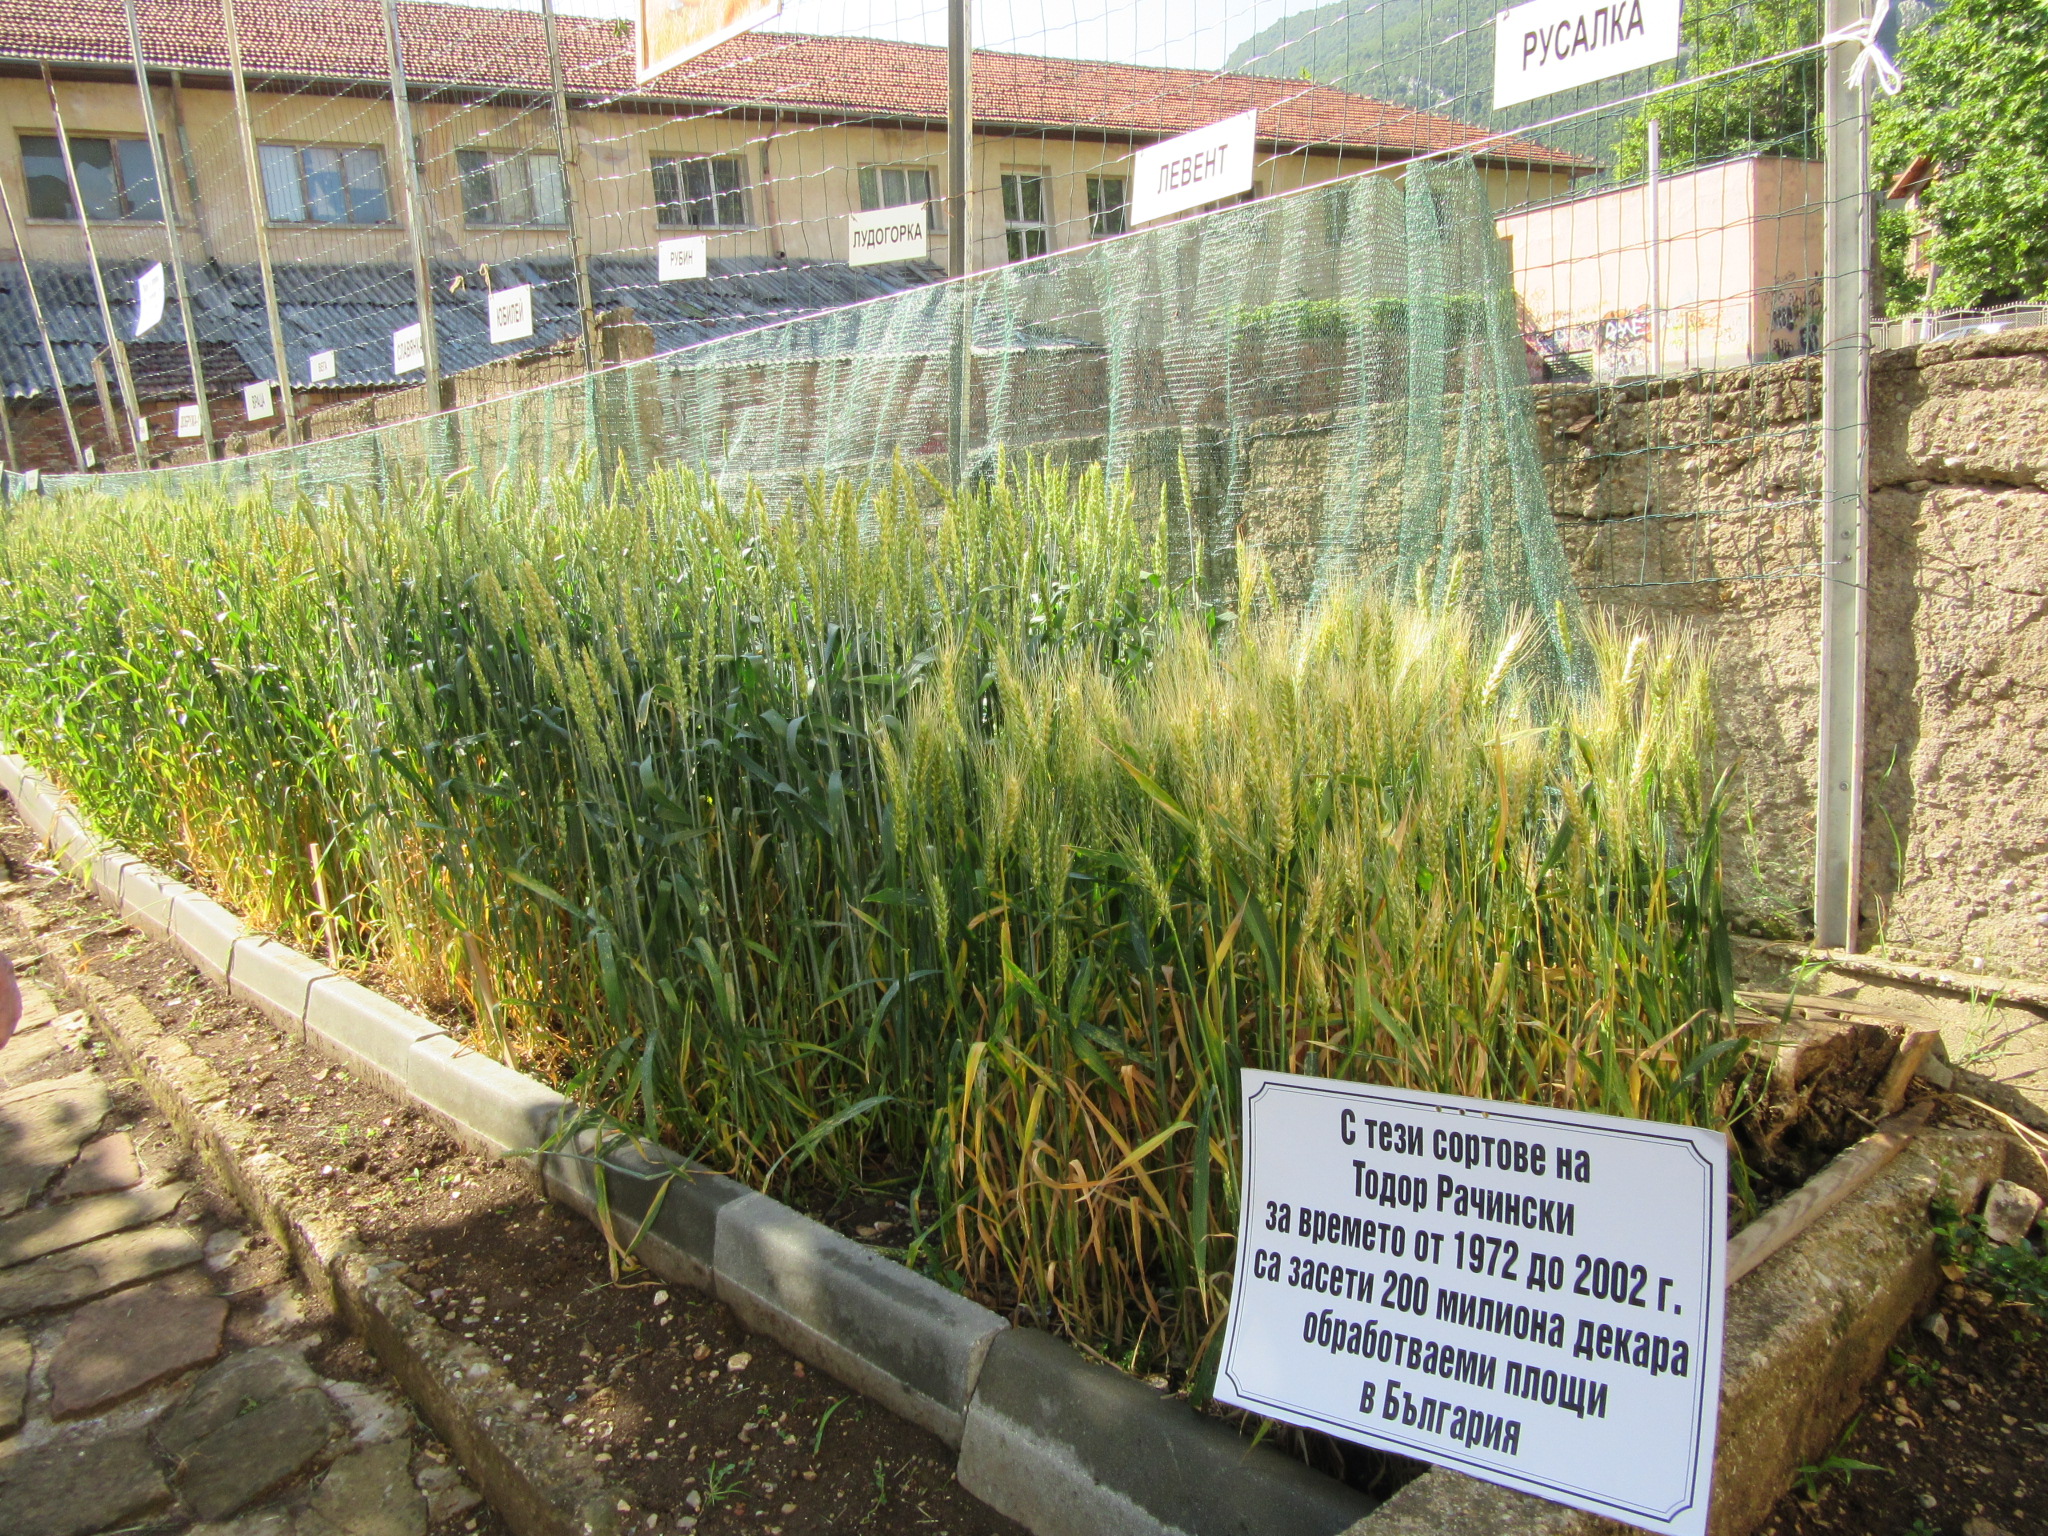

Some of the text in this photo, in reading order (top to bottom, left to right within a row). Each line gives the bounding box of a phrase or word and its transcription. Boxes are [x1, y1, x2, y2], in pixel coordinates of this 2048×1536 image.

[1522, 0, 1645, 71] РУСАЛКА
[1157, 143, 1229, 194] ЛЕВЕНТ
[670, 249, 693, 266] РУБИН
[852, 221, 923, 248] ЛУДОГОРКА
[496, 297, 524, 327] ЮБИЛЕЙ
[1341, 1109, 1590, 1183] С тези сортове на
[1353, 1160, 1574, 1236] Тодор Рачински
[1266, 1201, 1681, 1315] за времето от 1972 до 2002 г.
[1254, 1249, 1688, 1377] са засети 200 милиона декара
[1304, 1309, 1607, 1418] обработваеми площи
[1360, 1380, 1520, 1455] в България
